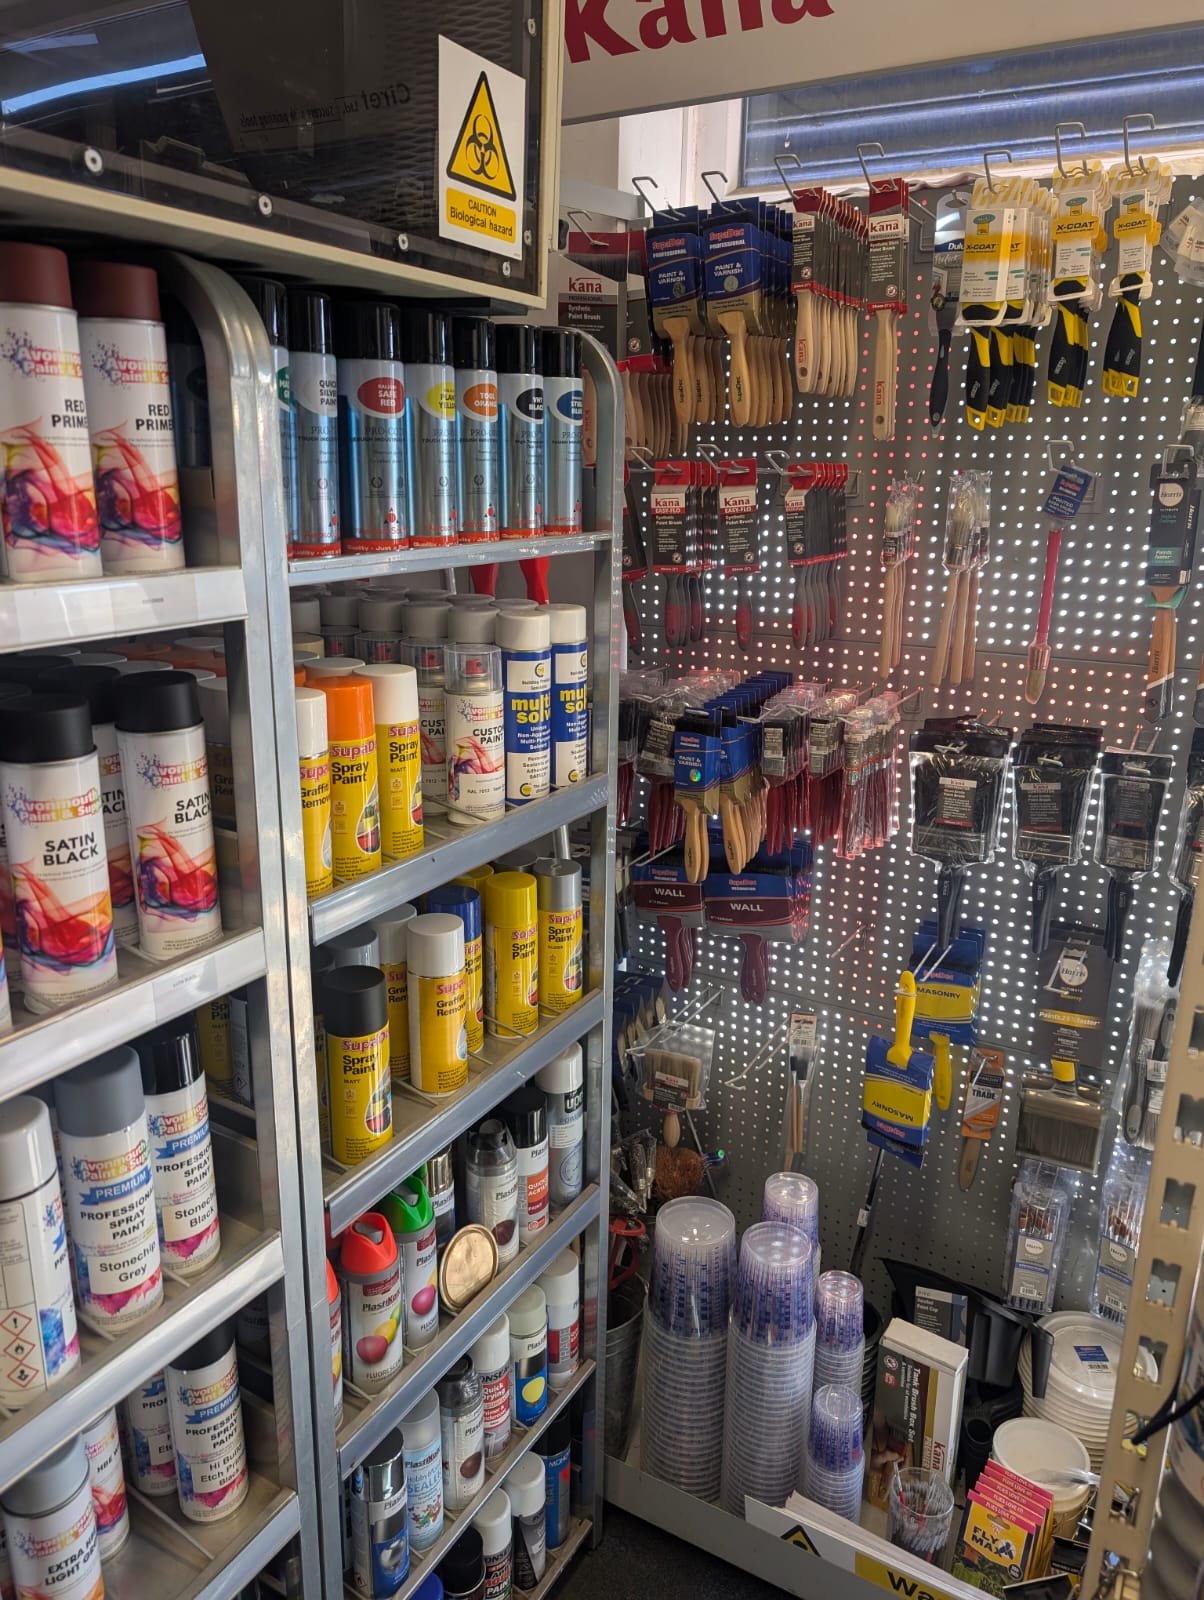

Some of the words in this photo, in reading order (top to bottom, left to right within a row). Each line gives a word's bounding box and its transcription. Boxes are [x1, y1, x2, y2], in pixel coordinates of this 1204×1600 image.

[468, 199, 497, 217] CAUTION
[450, 206, 487, 228] Biological
[489, 219, 513, 237] hazard
[870, 219, 899, 233] kana
[1056, 220, 1095, 231] X-COAT
[1117, 219, 1147, 229] X-COAT
[713, 268, 744, 277] VARNISH
[714, 263, 734, 271] PAINT
[658, 271, 677, 279] PAINT
[568, 277, 602, 293] kana
[874, 379, 885, 406] kana
[65, 399, 85, 413] RED
[149, 404, 169, 416] RED
[656, 497, 680, 507] kana
[724, 496, 750, 507] kana
[389, 739, 419, 756] Spray
[389, 752, 418, 763] Paint
[331, 762, 369, 777] Spray
[331, 773, 367, 785] Paint
[176, 792, 211, 812] SATIN
[45, 831, 95, 853] SATIN
[43, 843, 99, 867] BLACK
[654, 887, 686, 897] WALL
[729, 902, 764, 912] WALL
[547, 926, 575, 938] Spray
[548, 934, 573, 943] Paint
[512, 940, 536, 955] Spray
[512, 949, 535, 960] Paint
[916, 986, 961, 999] MASONRY
[342, 1054, 378, 1068] Spray
[343, 1062, 376, 1075] Paint
[972, 1089, 997, 1100] TRADE
[871, 1100, 914, 1122] MASONRY
[171, 1123, 209, 1151] PREMIU
[183, 1156, 210, 1178] SPRAY
[186, 1166, 211, 1188] PAINT
[95, 1172, 147, 1199] PREMIUM
[109, 1206, 146, 1230] SPRAY
[189, 1206, 215, 1228] Black
[111, 1219, 146, 1240] PAINT
[99, 1240, 156, 1273] Stonechip
[118, 1263, 147, 1282] Grey
[912, 1367, 921, 1386] Tank
[482, 1382, 504, 1394] Quick
[910, 1387, 919, 1411] Brush
[908, 1413, 918, 1428] Box
[210, 1416, 238, 1441] SPRAY
[906, 1428, 917, 1443] Set
[213, 1426, 238, 1449] PAINT
[932, 1441, 946, 1471] kana
[97, 1458, 113, 1473] HBE
[209, 1461, 221, 1472] Hi
[200, 1470, 225, 1483] Etch
[218, 1467, 240, 1487] Black
[973, 1525, 1000, 1545] FLY
[971, 1534, 1002, 1558] MAX
[48, 1547, 85, 1575] EXTRA
[44, 1565, 81, 1587] LIGHT
